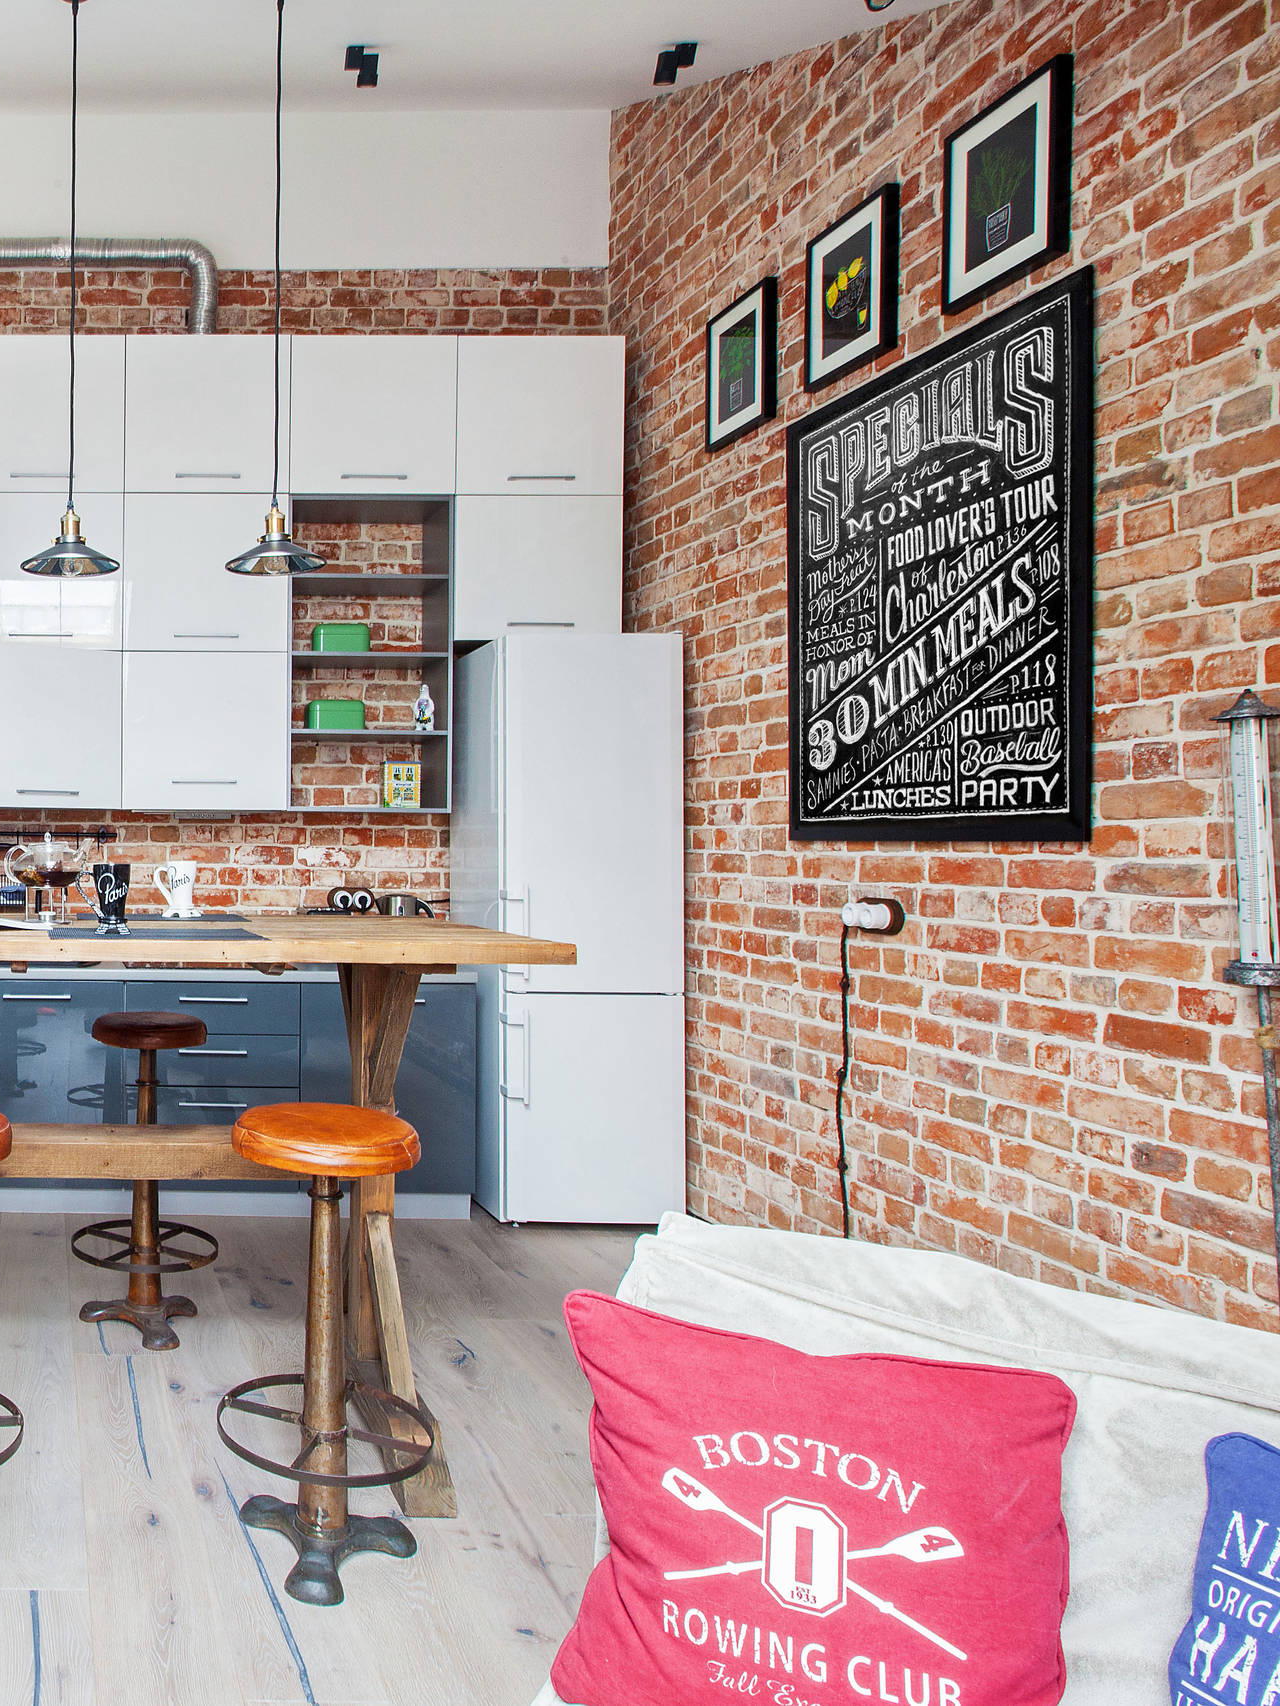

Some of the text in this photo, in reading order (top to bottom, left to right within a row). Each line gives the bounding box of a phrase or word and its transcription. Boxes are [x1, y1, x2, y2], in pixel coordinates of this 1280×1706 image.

[808, 326, 1054, 561] SPECIALS
[891, 460, 945, 494] of the
[846, 458, 991, 540] MONTH
[887, 474, 1058, 571] FOOD LOVER'S TOUR
[885, 541, 996, 644] Charleston
[911, 561, 934, 588] of
[808, 589, 835, 627] Day
[806, 611, 876, 645] MEALS IN
[806, 629, 877, 662] HONOR OF
[805, 647, 876, 713] Mom
[808, 694, 870, 771] 30
[868, 634, 934, 729] MIN.
[931, 551, 1036, 679] MEALS
[807, 606, 1057, 810] SAMMIES PASTA BREAKFAST FOR DINNER
[960, 697, 1057, 738] OUTDOOR
[885, 748, 951, 786] AMERICA'S
[960, 727, 1061, 776] Baseball
[850, 784, 951, 811] LUNCHES
[961, 772, 1060, 807] PARTY
[97, 872, 129, 905] Paris
[167, 865, 191, 890] Paris
[692, 1430, 926, 1514] BOSTON
[790, 1590, 817, 1604] 1933
[662, 1599, 962, 1706] ROWING CLUB
[706, 1660, 761, 1697] Fall
